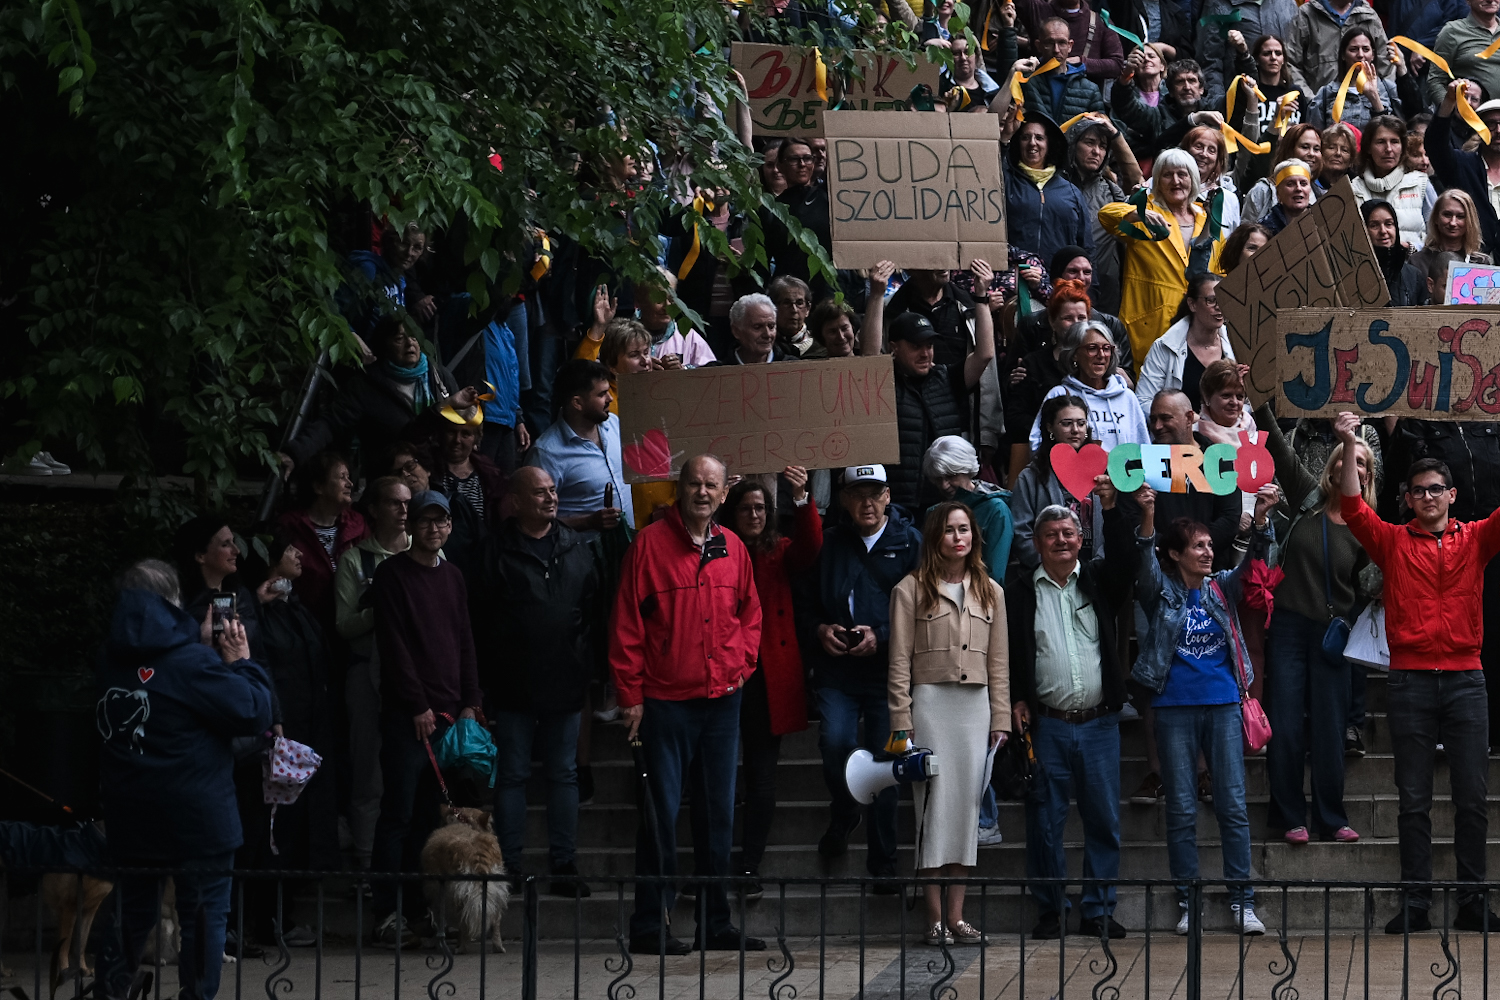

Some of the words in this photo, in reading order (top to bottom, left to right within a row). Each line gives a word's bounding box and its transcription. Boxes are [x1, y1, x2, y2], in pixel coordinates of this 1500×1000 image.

[835, 139, 981, 184] BUDA
[1219, 194, 1346, 307] VELED
[649, 367, 896, 429] SZERETÜNK
